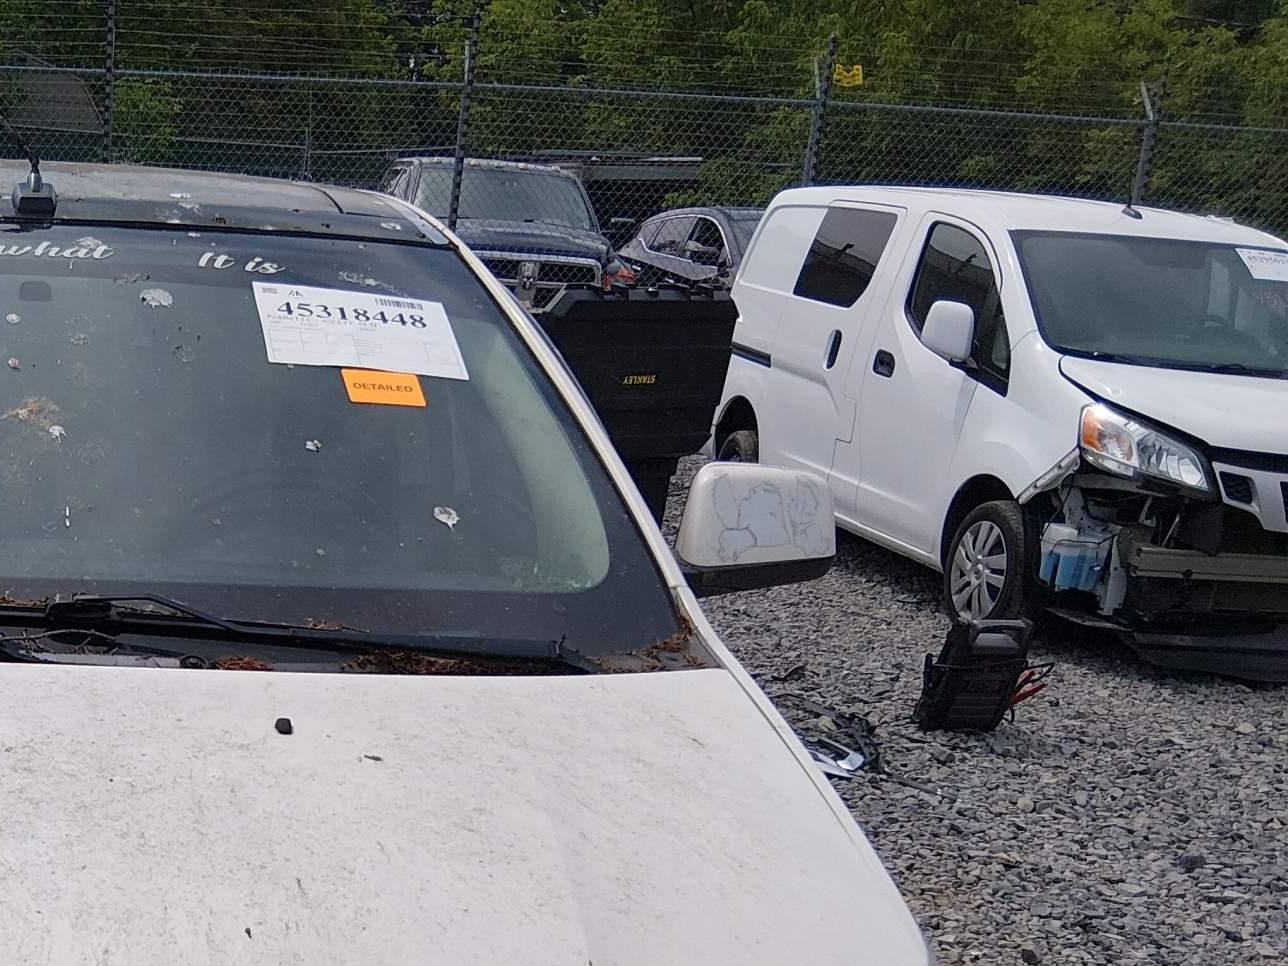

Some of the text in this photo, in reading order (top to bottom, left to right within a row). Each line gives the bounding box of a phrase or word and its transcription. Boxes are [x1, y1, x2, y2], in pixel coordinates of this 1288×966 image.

[198, 252, 235, 269] It
[245, 257, 286, 274] is
[277, 301, 428, 329] 45318448
[353, 382, 413, 393] DETAILED
[623, 374, 656, 385] STANLEY
